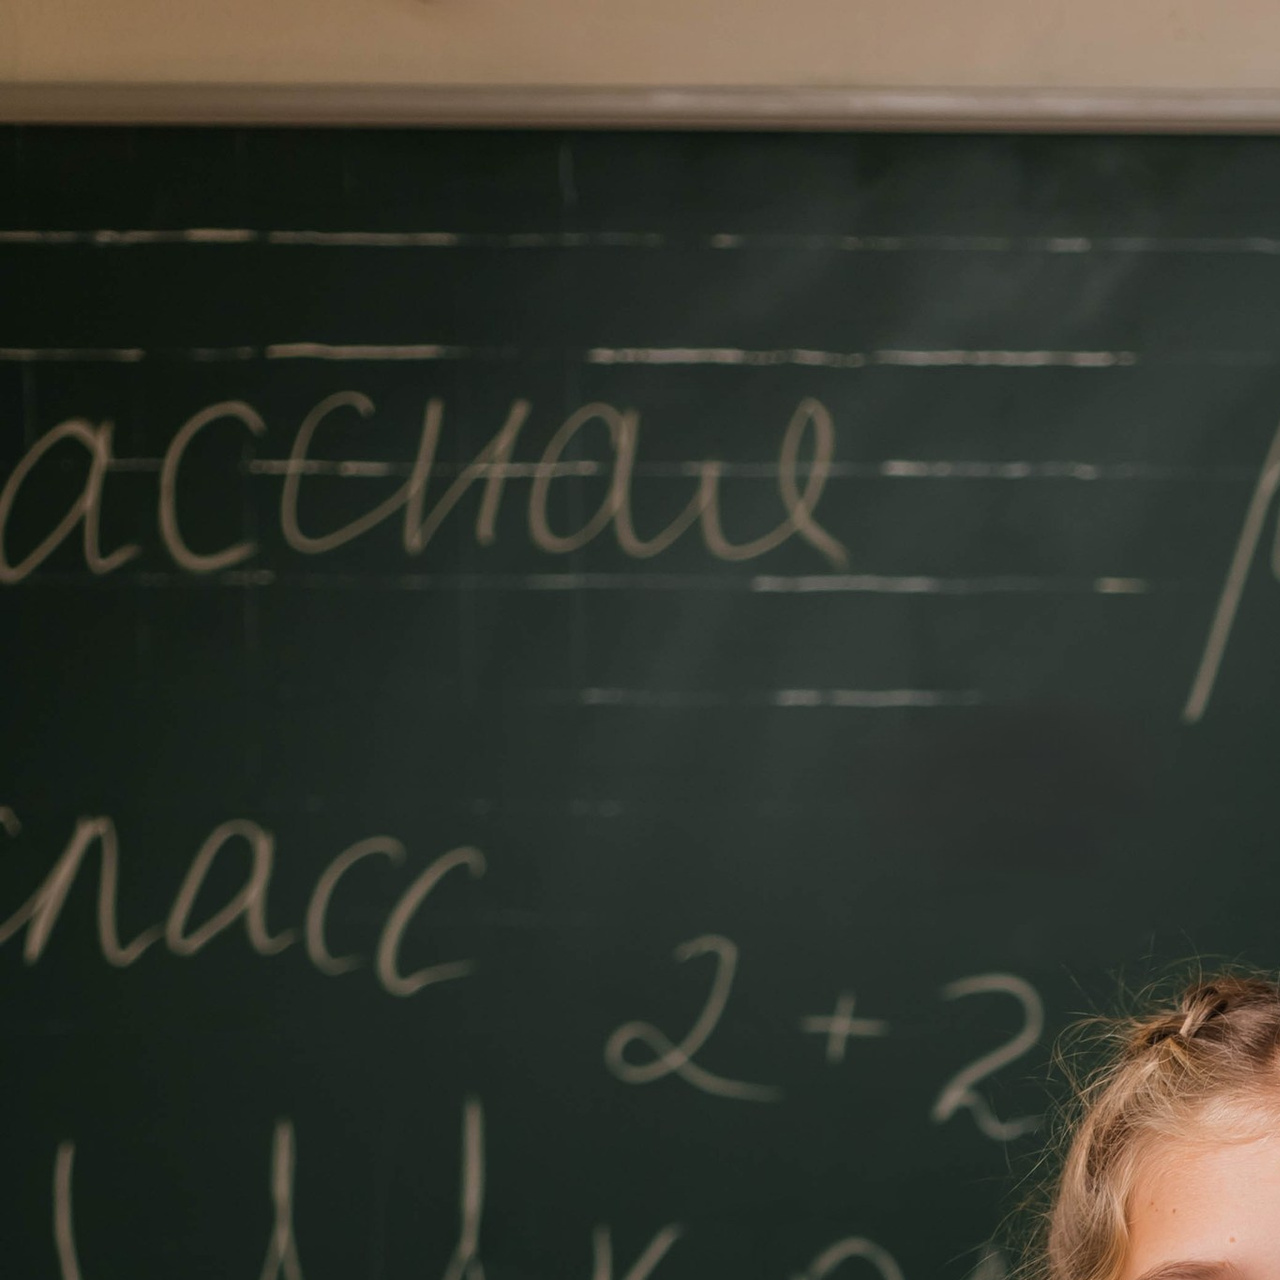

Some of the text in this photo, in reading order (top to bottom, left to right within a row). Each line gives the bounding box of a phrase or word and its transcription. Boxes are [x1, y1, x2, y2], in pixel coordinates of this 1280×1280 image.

[0, 805, 488, 998] ласс
[605, 935, 1044, 1140] 2 + 2
